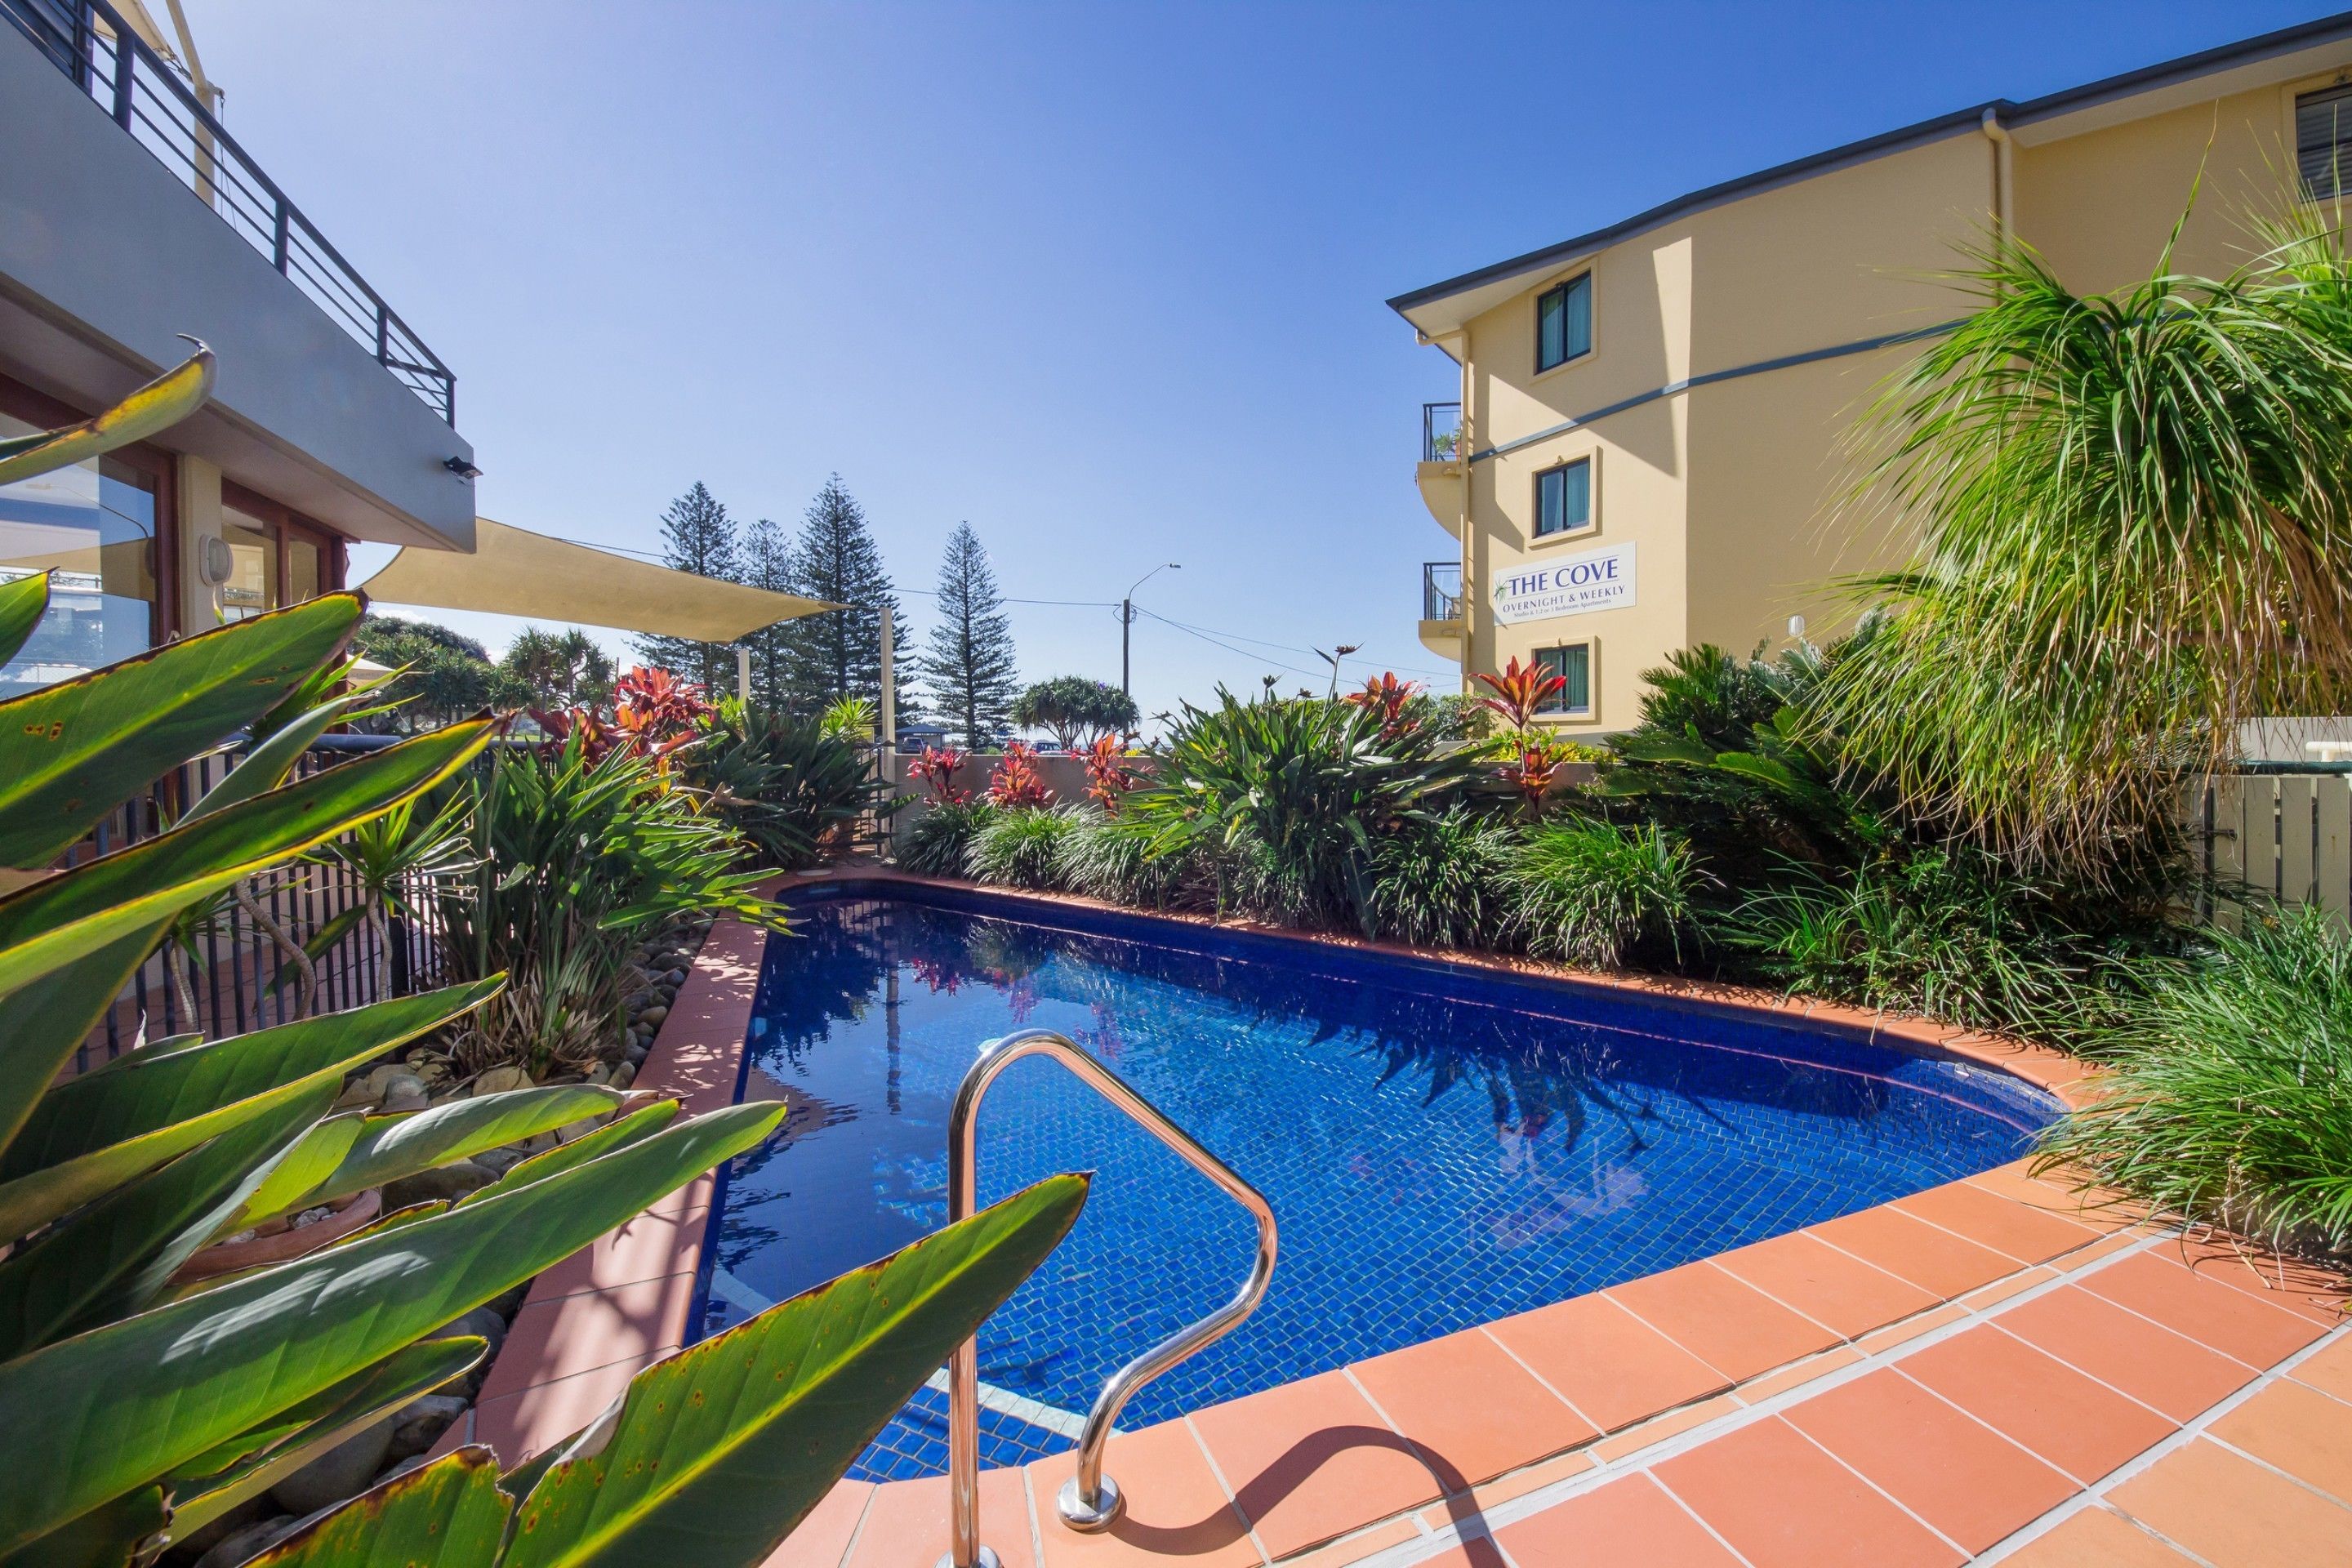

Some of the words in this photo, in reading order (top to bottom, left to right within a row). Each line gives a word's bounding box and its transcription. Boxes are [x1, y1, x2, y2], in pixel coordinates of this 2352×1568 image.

[1508, 572, 1548, 595] THE
[1555, 559, 1618, 588] COVE
[1503, 595, 1565, 613] OVERNIGHT
[1568, 594, 1576, 603] &
[1579, 585, 1625, 600] WEEKLY
[1581, 599, 1611, 608] Apartments
